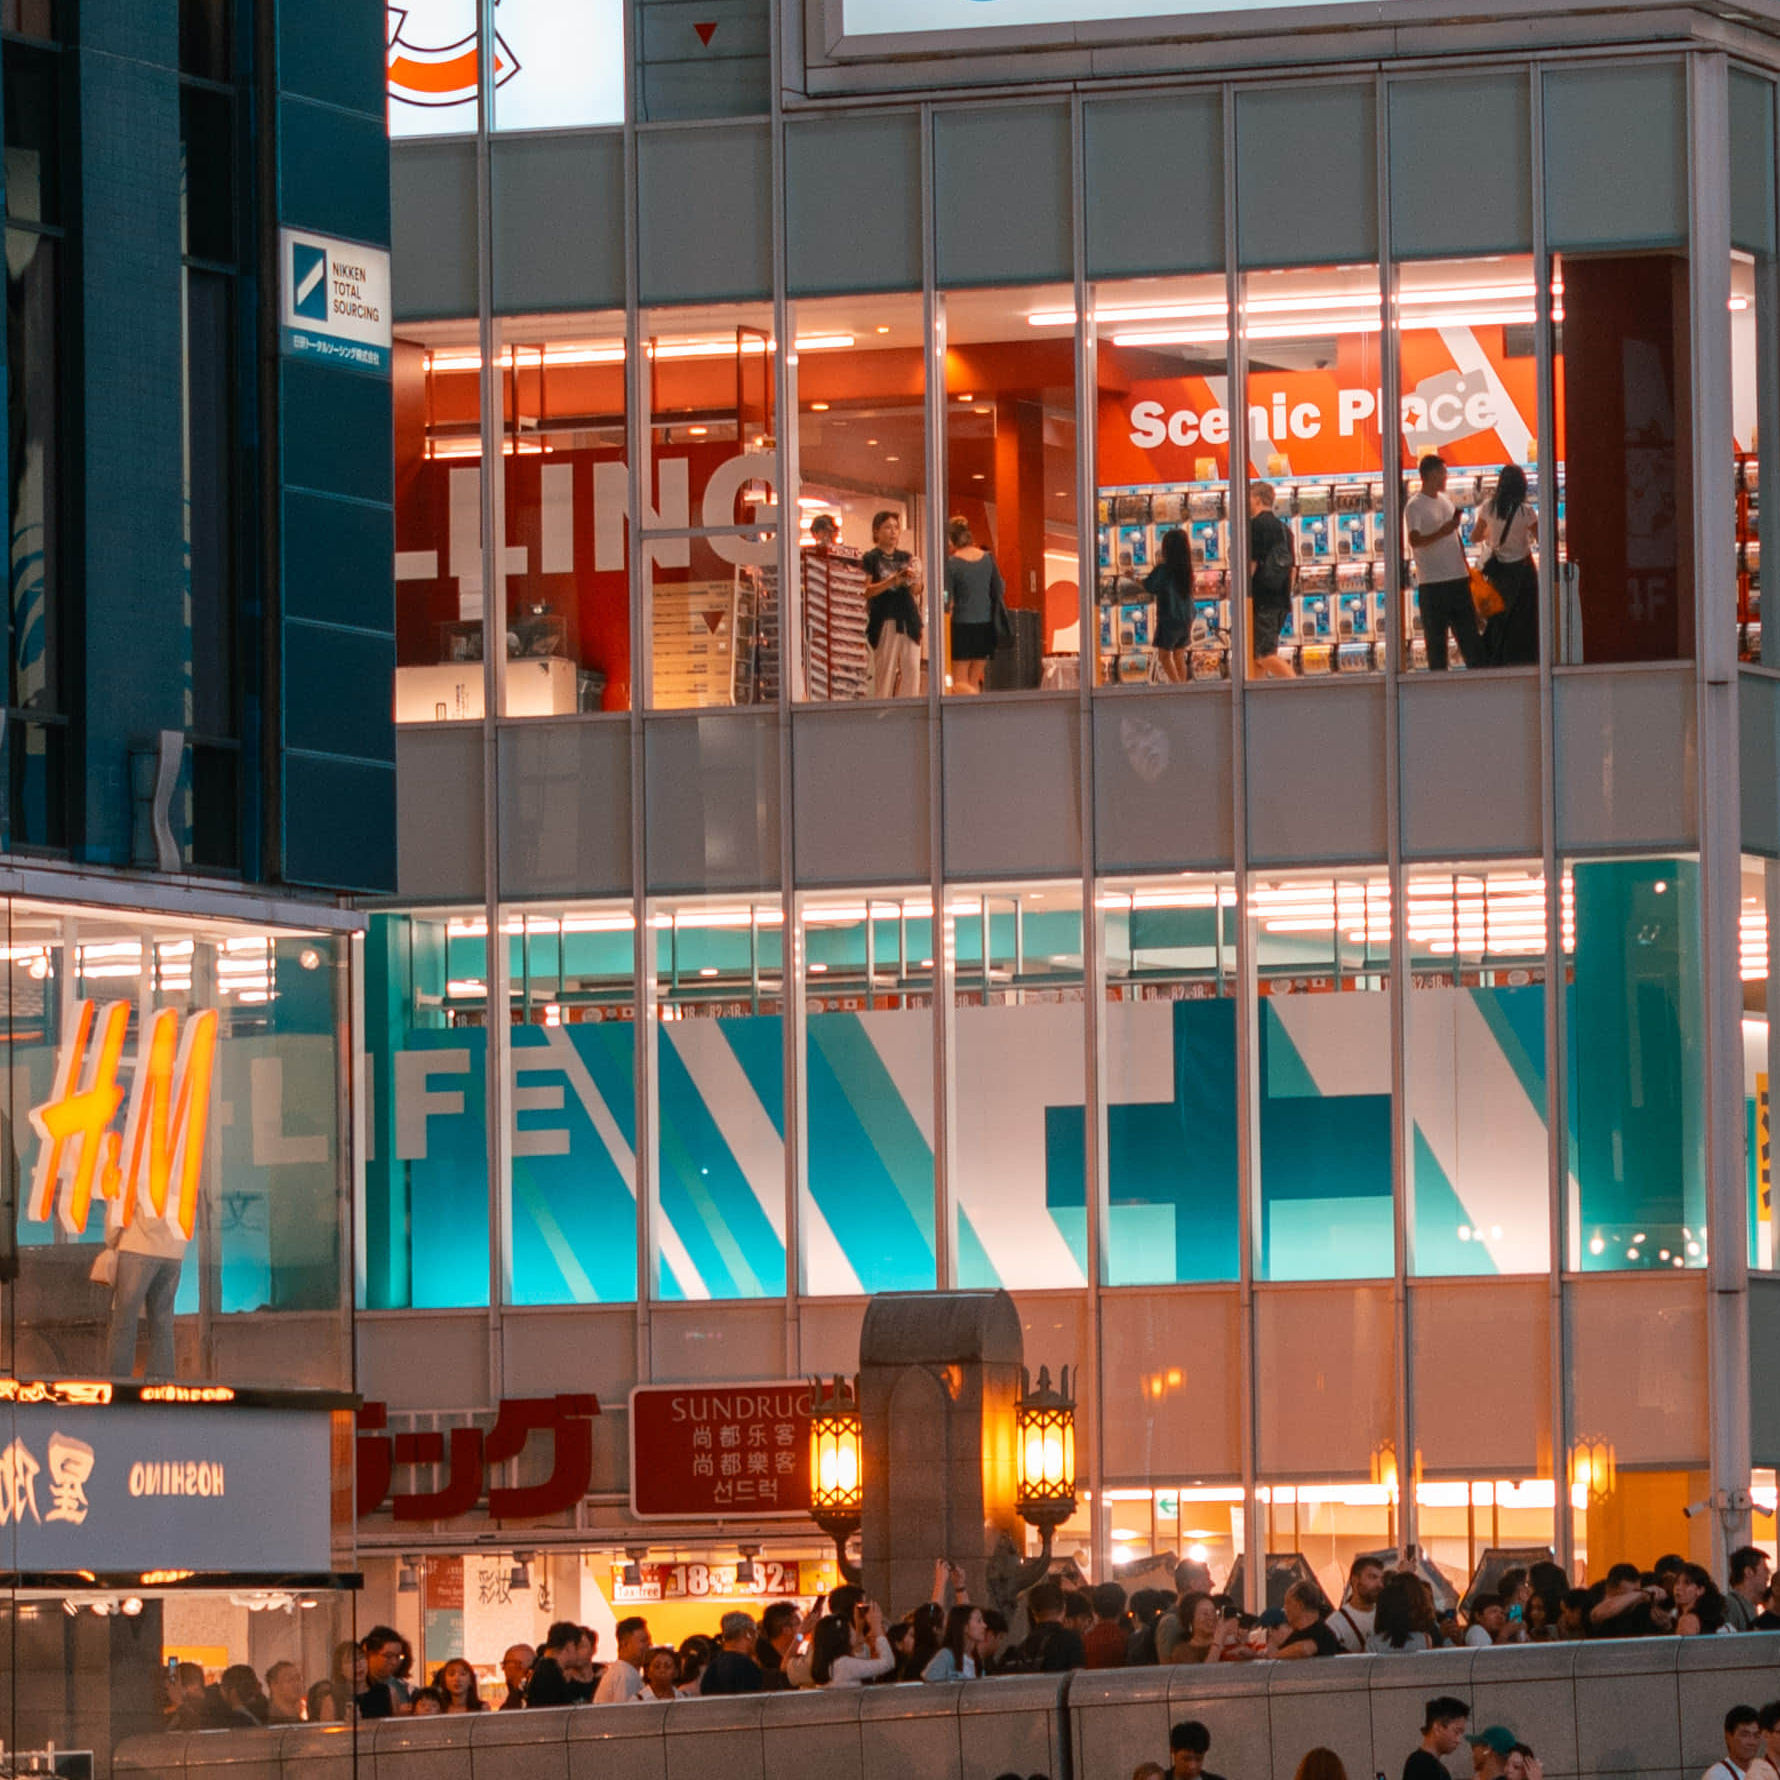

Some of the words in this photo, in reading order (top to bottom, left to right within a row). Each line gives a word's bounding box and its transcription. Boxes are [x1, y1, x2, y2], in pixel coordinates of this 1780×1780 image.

[332, 262, 367, 283] NIKKEN
[333, 281, 362, 301] TOTAL
[333, 299, 380, 323] SOURCING
[1129, 392, 1321, 448] Scenic
[29, 998, 218, 1241] H&M
[712, 1478, 780, 1505] 선드럭
